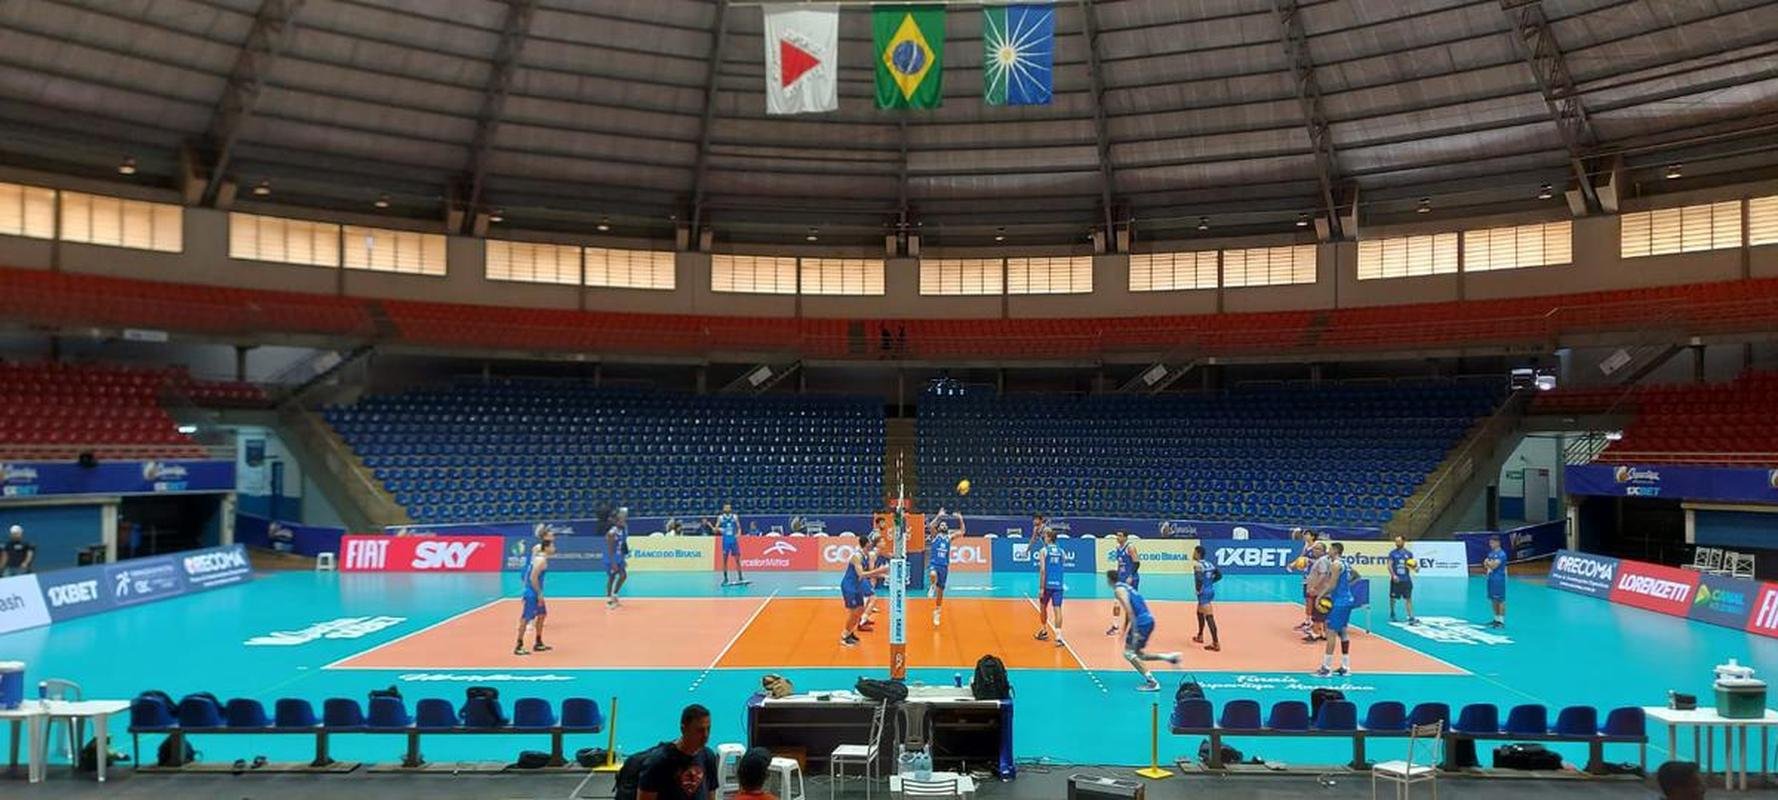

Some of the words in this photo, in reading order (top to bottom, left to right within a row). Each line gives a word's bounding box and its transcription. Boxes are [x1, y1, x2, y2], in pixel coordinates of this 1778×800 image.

[192, 549, 247, 573] RECOMA
[346, 540, 390, 569] FIAT
[412, 541, 480, 568] SKY
[634, 550, 663, 558] BANCO
[664, 550, 674, 558] DO
[675, 550, 701, 558] BRASIL
[741, 558, 789, 567] rcelorMittal
[823, 545, 852, 563] GO
[949, 544, 986, 563] GOL
[1162, 552, 1189, 561] BRASIL
[1215, 548, 1292, 566] 1XBET
[1420, 558, 1434, 568] EY
[1566, 557, 1612, 581] RECOMA
[48, 581, 98, 606] 1XBET
[1618, 573, 1690, 602] LORENZETTI
